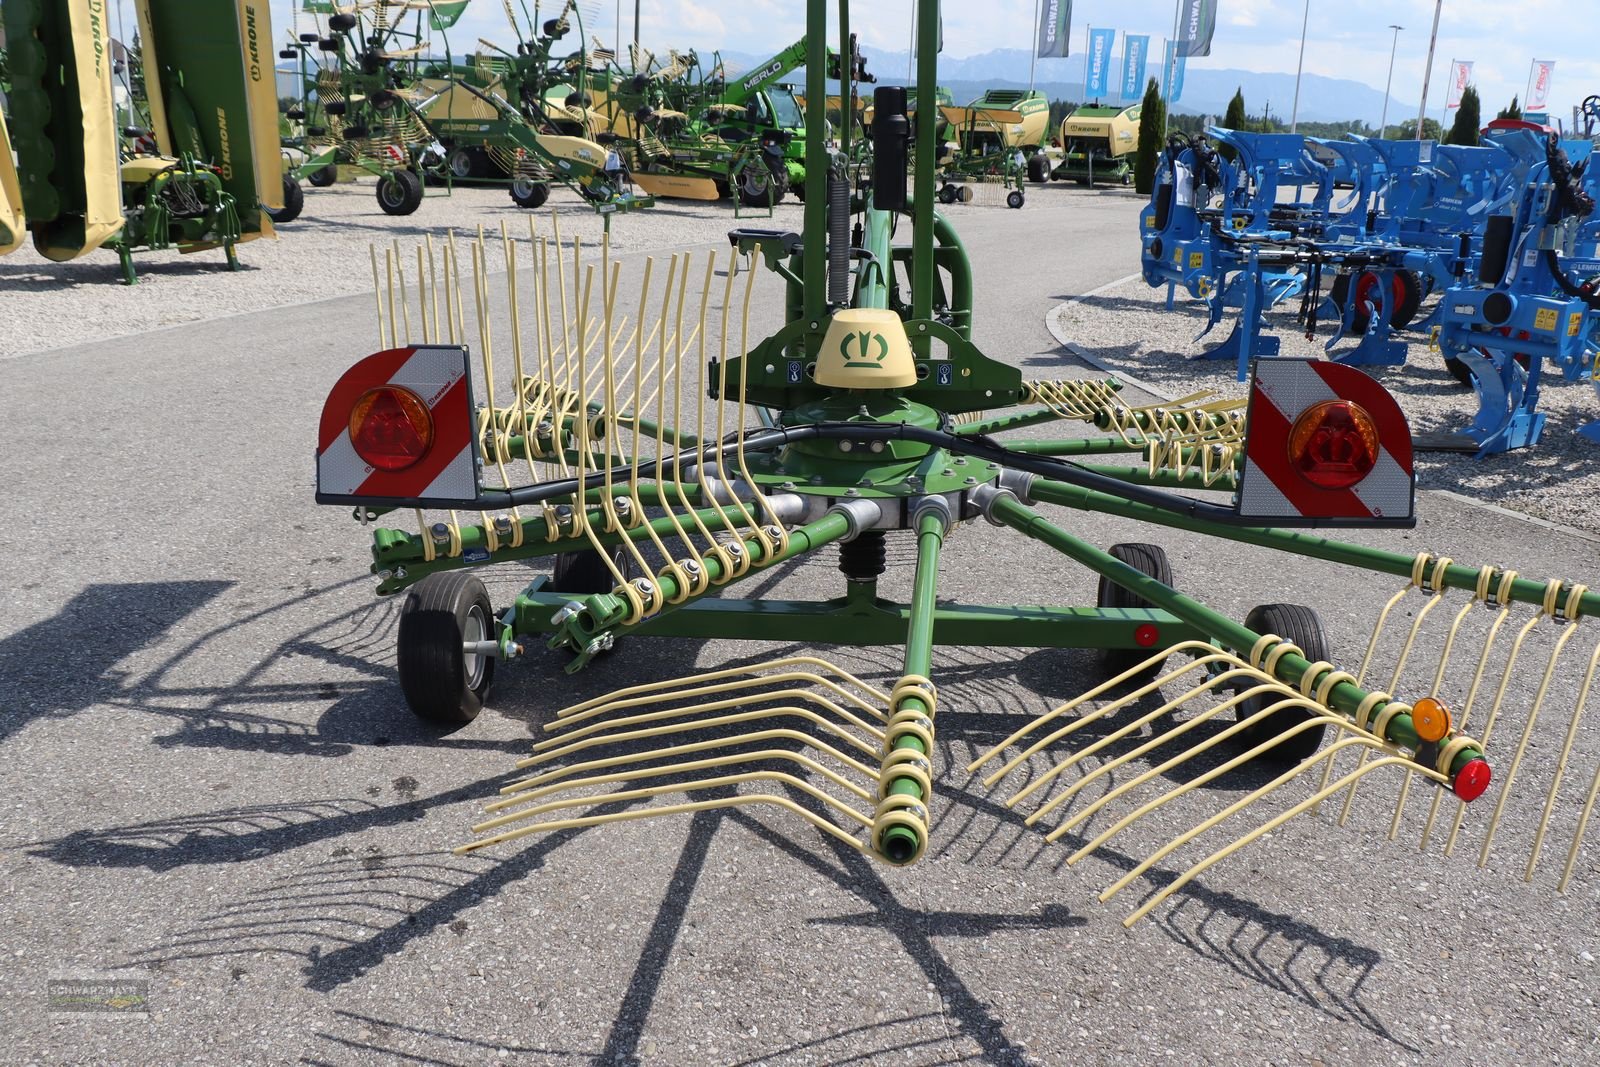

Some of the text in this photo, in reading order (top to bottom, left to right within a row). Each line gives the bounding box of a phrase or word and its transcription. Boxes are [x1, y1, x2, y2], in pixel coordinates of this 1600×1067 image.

[246, 5, 260, 64] KRONE
[744, 62, 782, 91] MERLO
[1092, 35, 1104, 79] LEMKEN
[1127, 41, 1139, 83] LEMKEN
[217, 107, 231, 163] KRONE
[1440, 196, 1463, 205] LEMKEN
